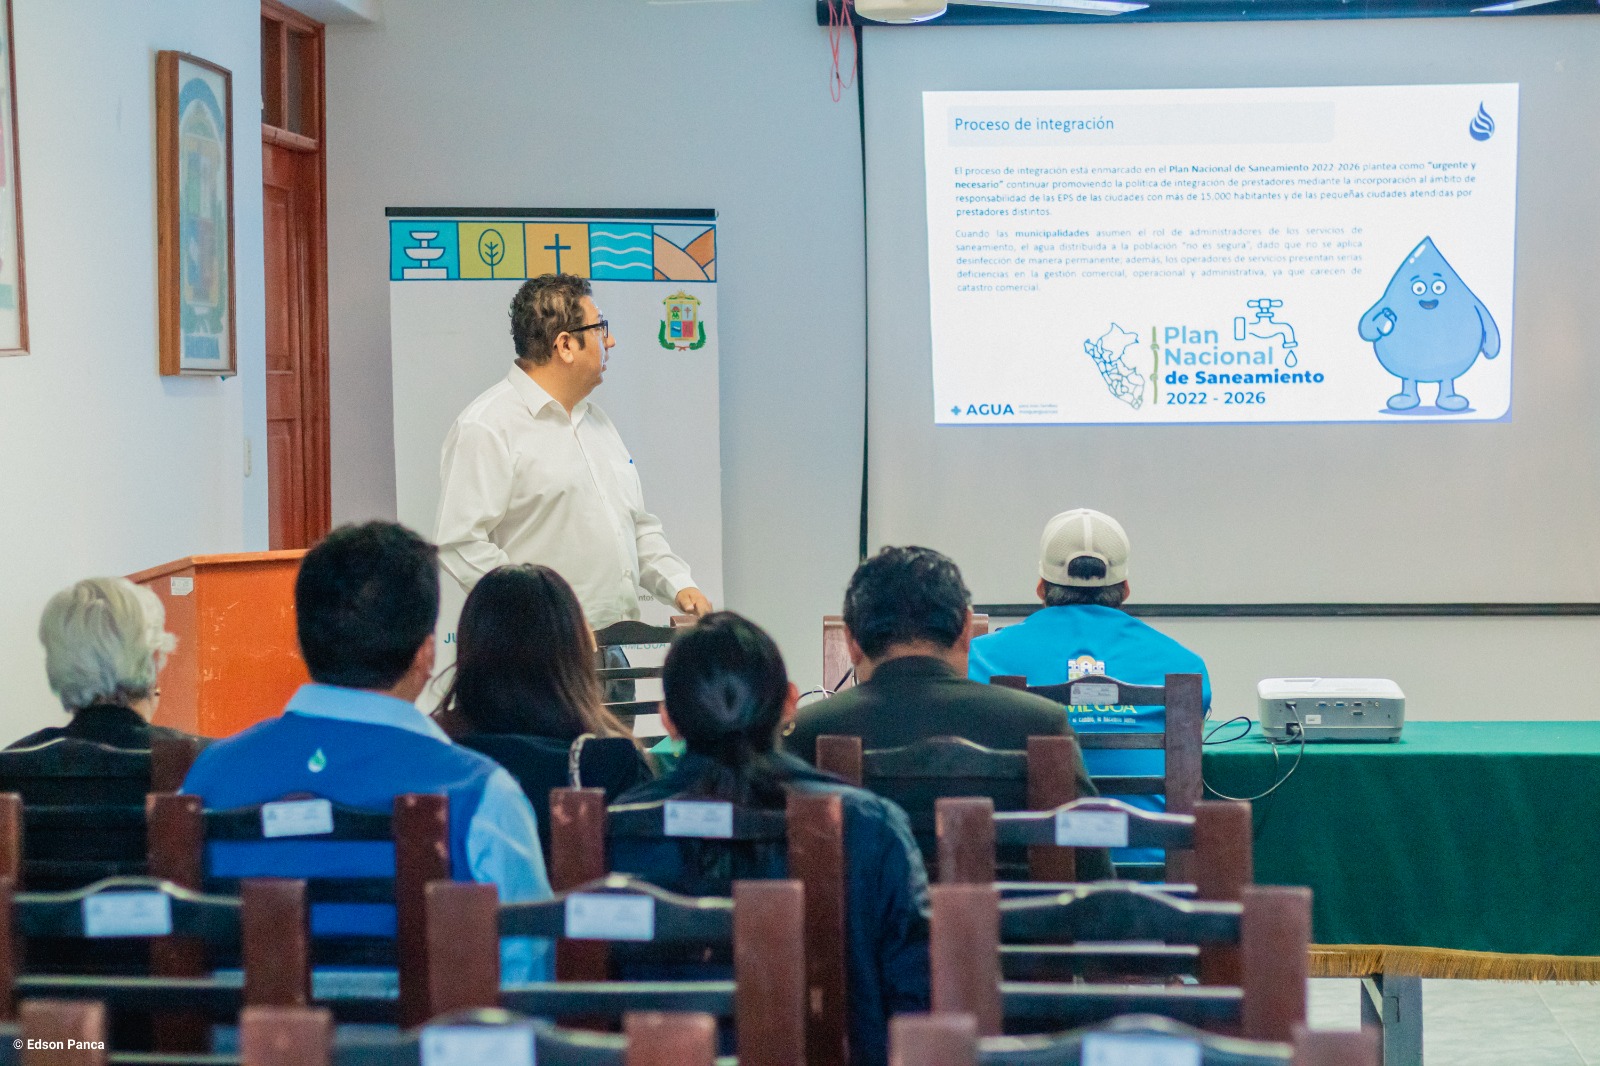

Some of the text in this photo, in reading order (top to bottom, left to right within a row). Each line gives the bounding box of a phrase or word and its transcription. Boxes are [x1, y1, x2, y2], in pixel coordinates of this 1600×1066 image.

[955, 115, 1115, 133] Proceso de integración
[954, 166, 963, 175] El
[964, 168, 1001, 177] proceso
[1003, 165, 1015, 175] de
[1091, 164, 1142, 173] enmarcado
[1158, 163, 1167, 173] el
[1169, 163, 1190, 172] Plan
[1191, 163, 1232, 172] Nacional
[1234, 162, 1246, 172] de
[1248, 162, 1310, 171] Saneamiento
[1363, 161, 1397, 172] plantea
[1007, 179, 1049, 188] continuar
[1052, 178, 1112, 190] promoviendo
[1115, 178, 1123, 187] la
[1161, 177, 1172, 187] de
[1228, 176, 1238, 186] de
[1242, 176, 1294, 187] prestadores
[1298, 175, 1340, 185] mediante
[1344, 175, 1351, 184] la
[1420, 174, 1427, 184] al
[1464, 174, 1476, 183] de
[955, 193, 1027, 205] responsabilidad
[1029, 193, 1041, 202] de
[1043, 192, 1055, 202] las
[1057, 192, 1074, 202] EPS
[1076, 192, 1088, 202] de
[1090, 192, 1102, 201] las
[1104, 192, 1144, 201] ciudades
[1166, 191, 1184, 200] más
[1186, 191, 1198, 200] de
[1234, 190, 1282, 199] habitantes
[1291, 190, 1302, 199] de
[1305, 189, 1318, 199] las
[1320, 189, 1365, 200] pequeñas
[1366, 188, 1407, 198] ciudades
[1410, 188, 1455, 197] atendidas
[1456, 190, 1472, 199] por
[956, 206, 1052, 218] prestadores distintos.
[955, 229, 990, 238] Cuando
[996, 229, 1009, 238] las
[1015, 228, 1090, 240] municipalidades
[1137, 227, 1146, 237] el
[1153, 227, 1165, 237] rol
[1171, 227, 1184, 236] de
[1189, 227, 1262, 236] administradores
[1268, 226, 1280, 236] de
[1286, 226, 1299, 235] los
[1306, 226, 1345, 235] servicios
[1351, 225, 1363, 235] de
[955, 242, 1016, 253] saneamiento,
[1020, 242, 1030, 251] el
[1033, 244, 1055, 253] agua
[1059, 241, 1108, 251] distribuida
[1121, 241, 1130, 250] la
[1256, 240, 1280, 249] dado
[1284, 242, 1302, 251] que
[1336, 239, 1364, 250] aplica
[1014, 256, 1026, 265] de
[1165, 254, 1178, 264] los
[1181, 254, 1232, 265] operadores
[1234, 253, 1246, 263] de
[1248, 253, 1287, 263] servicios
[1289, 253, 1334, 264] presentan
[956, 269, 1009, 279] deficiencias
[1031, 269, 1040, 278] la
[1044, 268, 1077, 280] gestión
[1082, 268, 1127, 278] comercial,
[1133, 268, 1186, 279] operacional
[1201, 267, 1266, 277] administrativa,
[1272, 269, 1284, 278] ya
[1288, 269, 1305, 278] que
[1351, 266, 1362, 275] de
[957, 283, 992, 292] catastro
[1164, 325, 1219, 344] Plan
[1164, 346, 1274, 366] Nacional
[1165, 368, 1325, 384] de Saneamiento
[1166, 392, 1207, 404] 2022
[1224, 391, 1266, 404] 2026
[966, 404, 1014, 416] AGUA
